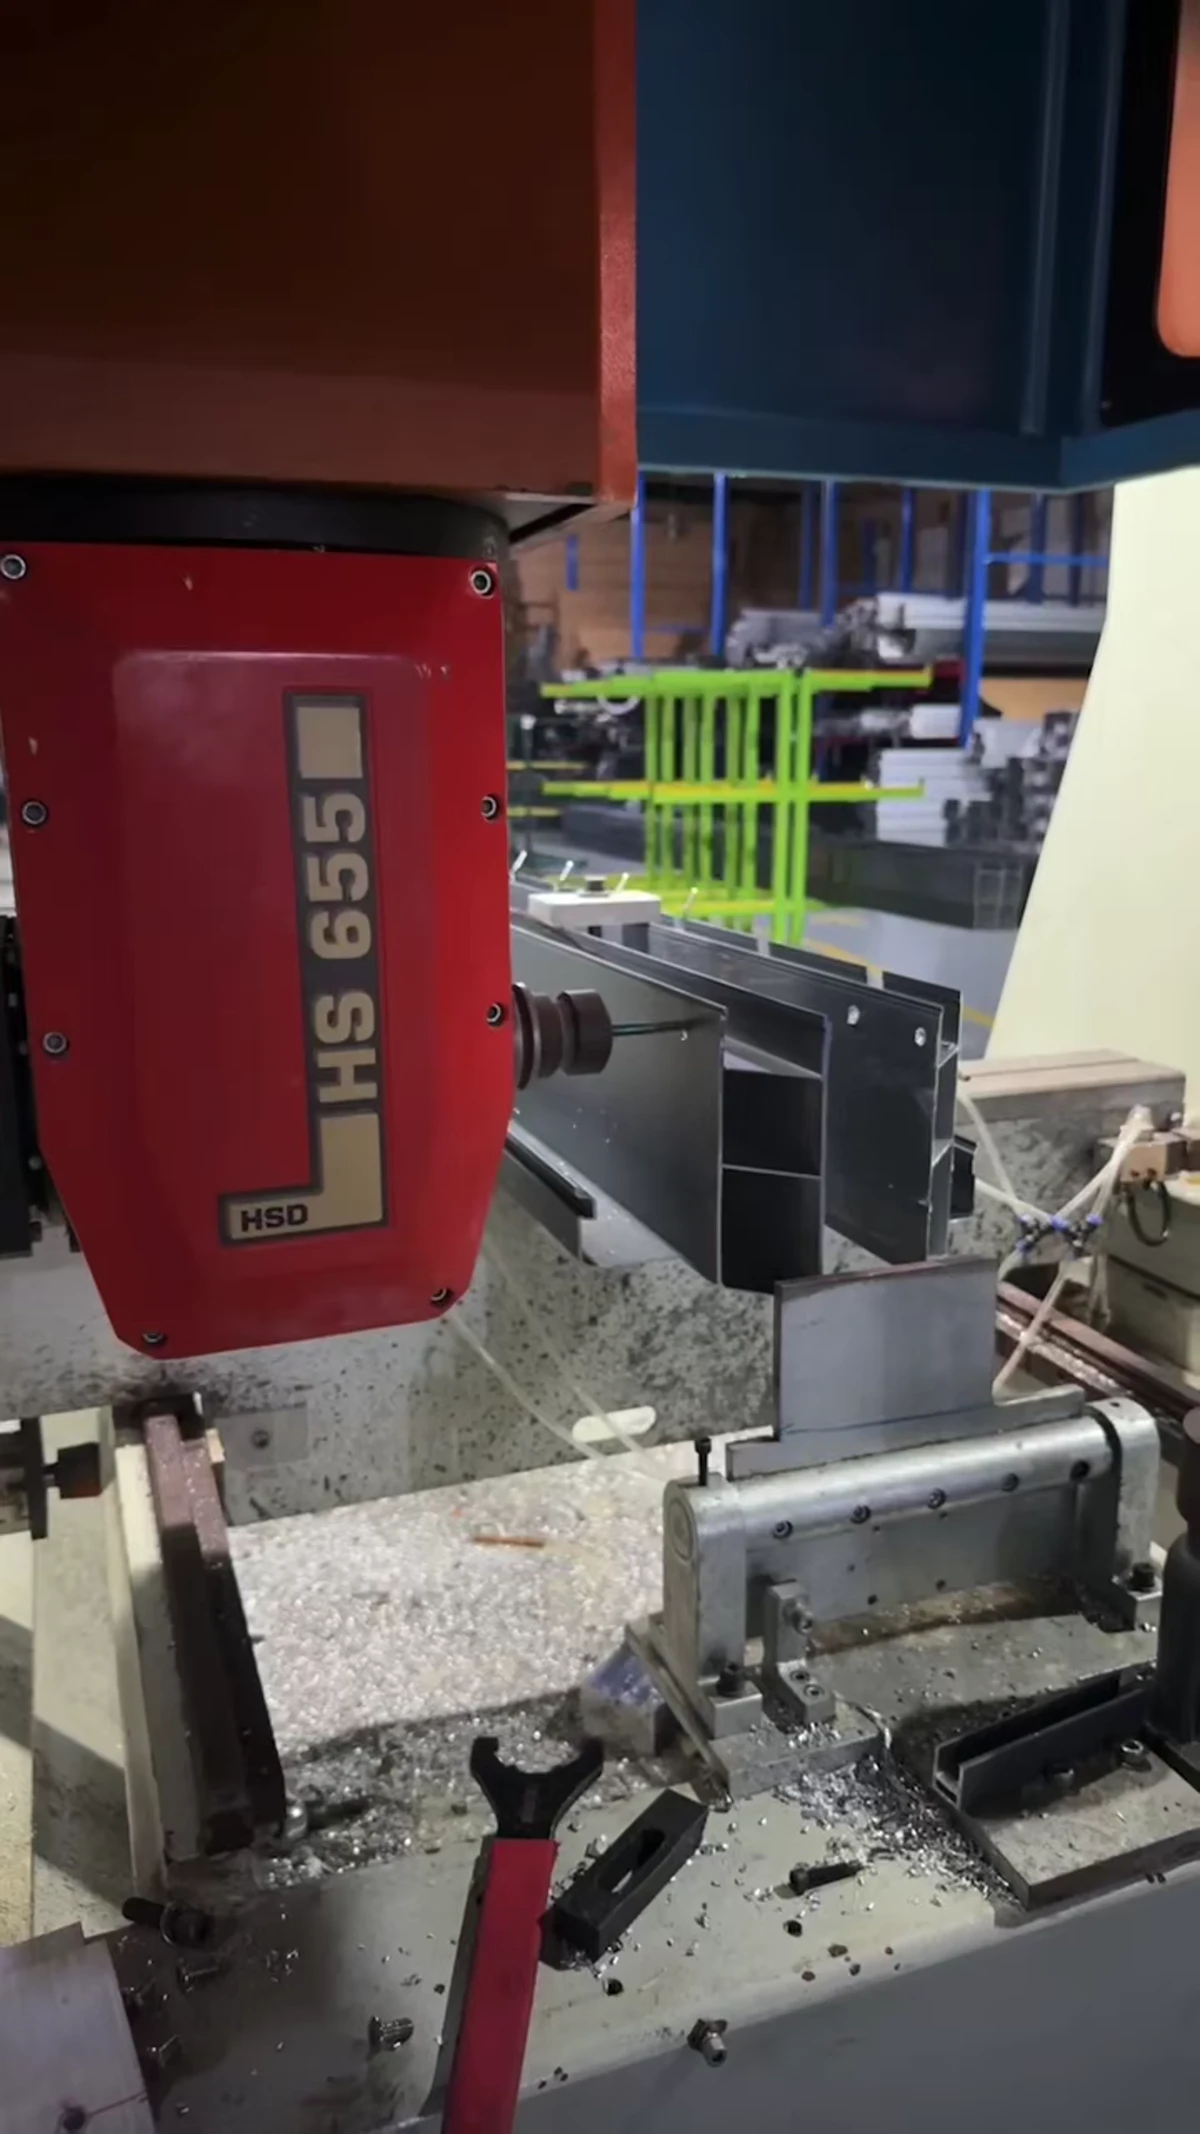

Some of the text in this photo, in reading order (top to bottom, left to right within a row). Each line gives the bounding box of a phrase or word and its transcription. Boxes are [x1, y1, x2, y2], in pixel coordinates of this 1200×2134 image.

[303, 791, 378, 1103] HS 655
[240, 1204, 309, 1233] HSD
